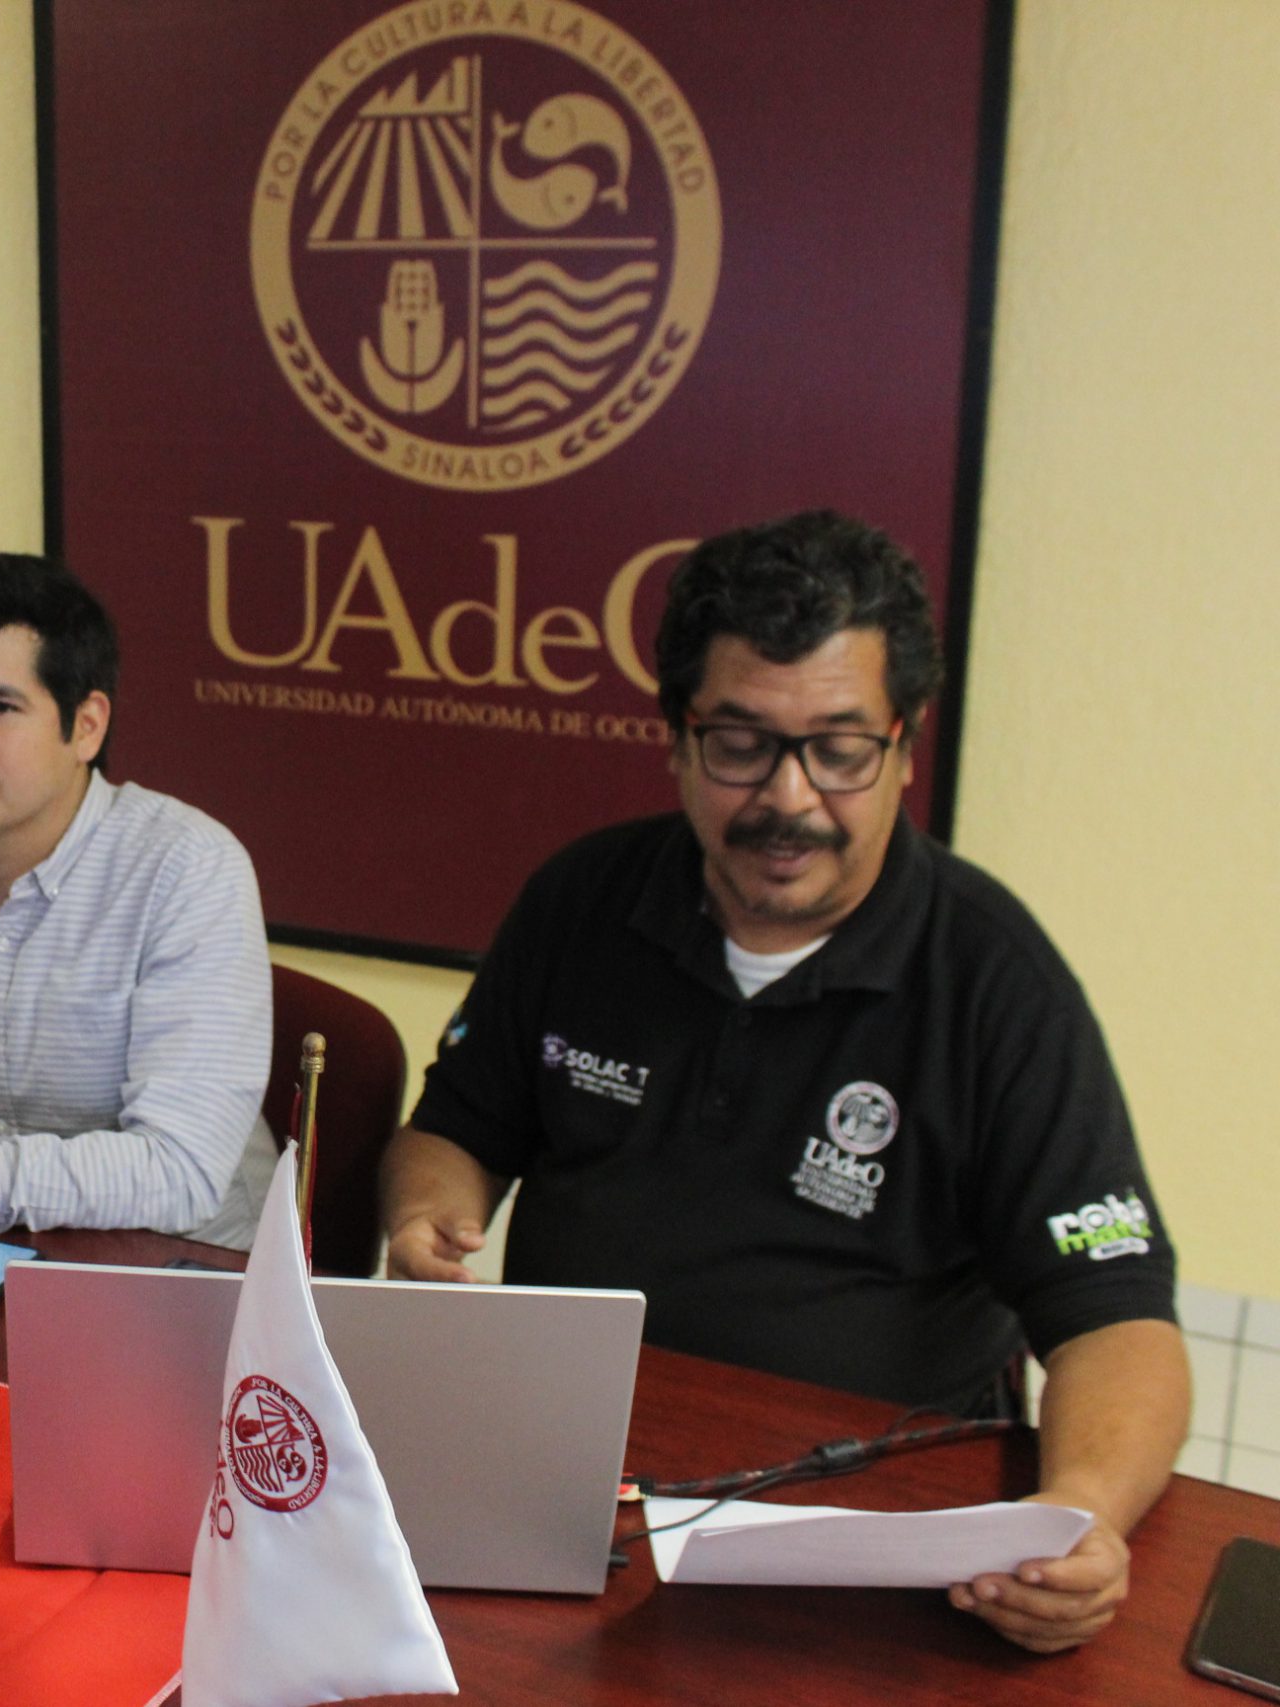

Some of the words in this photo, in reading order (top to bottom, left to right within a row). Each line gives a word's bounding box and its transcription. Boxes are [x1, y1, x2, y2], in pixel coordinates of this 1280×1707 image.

[265, 125, 304, 200] POR
[301, 80, 340, 120] LA
[339, 0, 494, 77] CULTURA
[506, 1, 529, 27] A
[542, 6, 585, 46] LA
[591, 33, 705, 194] LIBERTAD
[402, 442, 550, 483] SINALOA
[194, 679, 375, 718] UNIVERSIDAD
[380, 694, 543, 734] AUTÓNOMA
[549, 710, 591, 738] DE
[564, 1047, 651, 1088] SOLACT
[251, 1377, 269, 1392] POR
[269, 1384, 283, 1400] LA
[284, 1395, 318, 1440] CULTURA
[313, 1444, 323, 1454] A
[314, 1456, 325, 1470] LA
[287, 1471, 323, 1511] LIBERTAD
